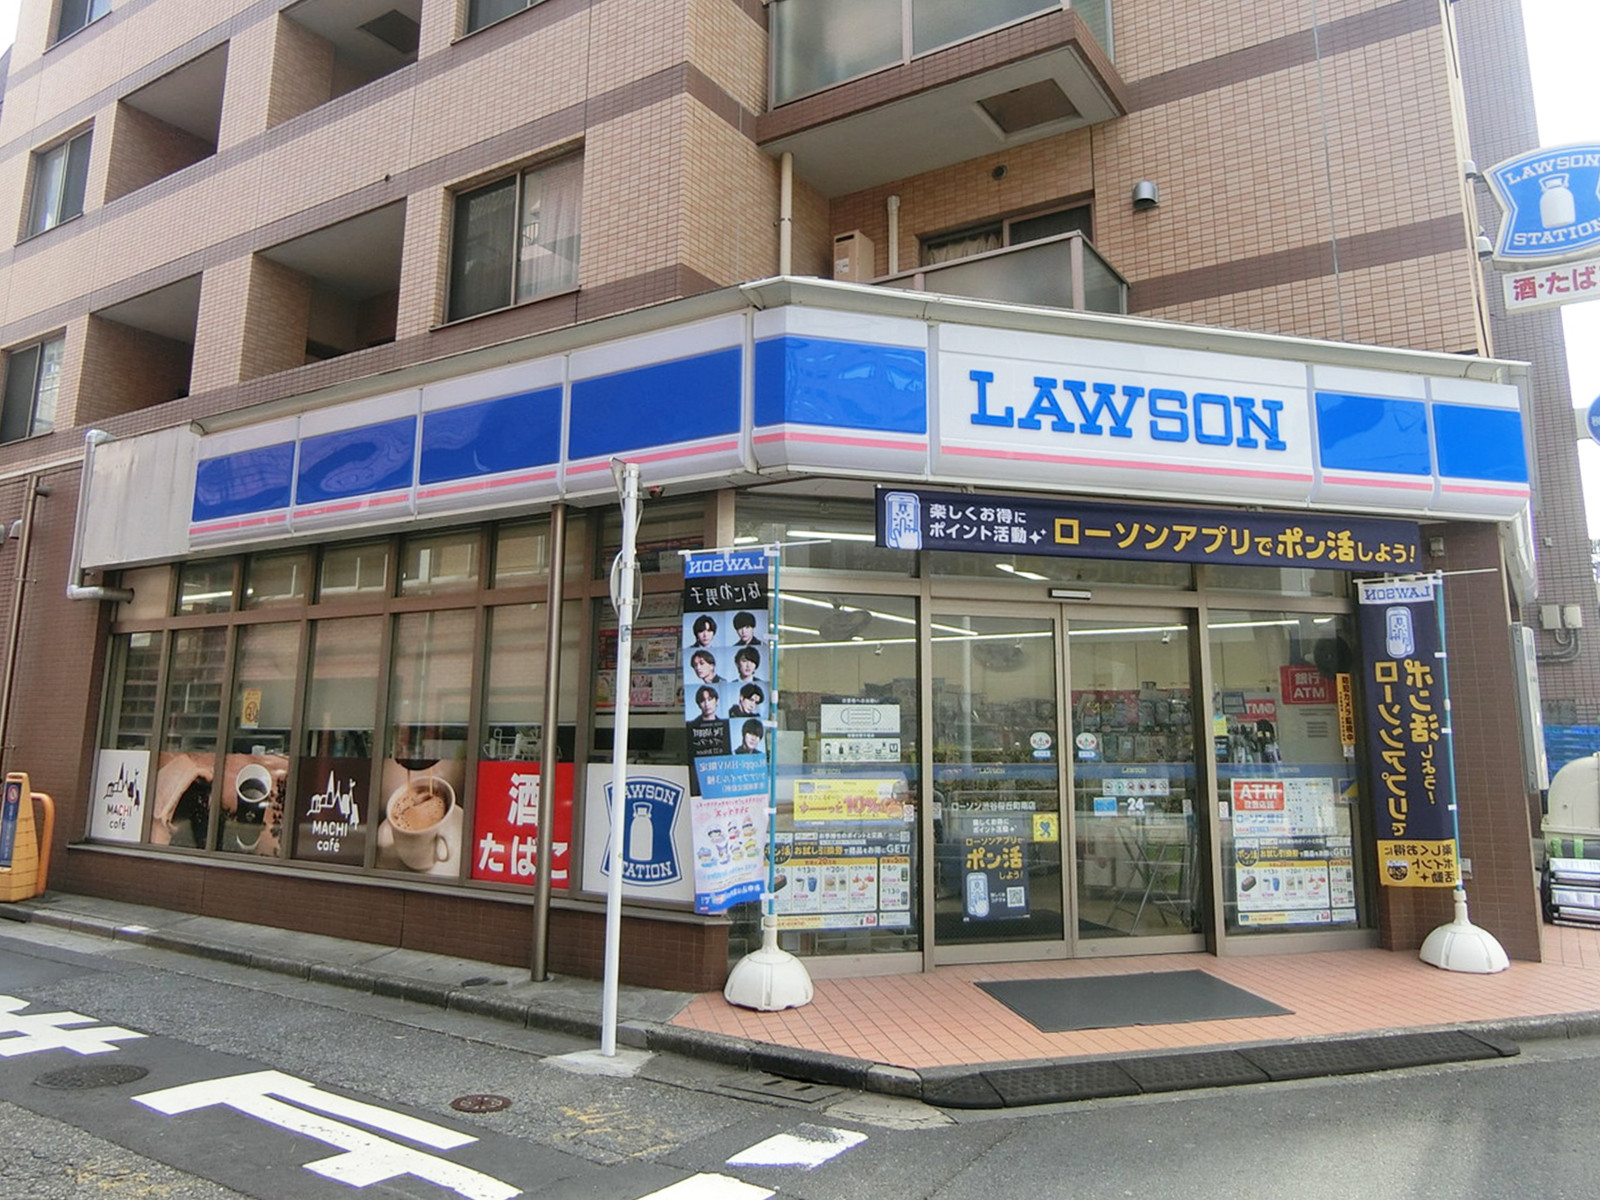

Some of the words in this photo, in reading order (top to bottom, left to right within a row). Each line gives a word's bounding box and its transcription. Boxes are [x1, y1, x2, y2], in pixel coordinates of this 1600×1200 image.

[1513, 264, 1600, 301] 酒・たば
[969, 369, 1287, 452] LAWSON
[929, 504, 1026, 524] 楽しくお得に
[929, 522, 1027, 545] ポイント活動
[1293, 687, 1325, 699] ATM
[508, 772, 540, 826] 酒
[624, 784, 677, 806] AWSON
[1239, 784, 1278, 799] ATM
[106, 803, 132, 817] MACHI
[1127, 797, 1144, 810] 24
[109, 819, 126, 830] café
[312, 820, 348, 837] MACHI
[317, 839, 340, 852] café
[966, 846, 1022, 870] ポン活
